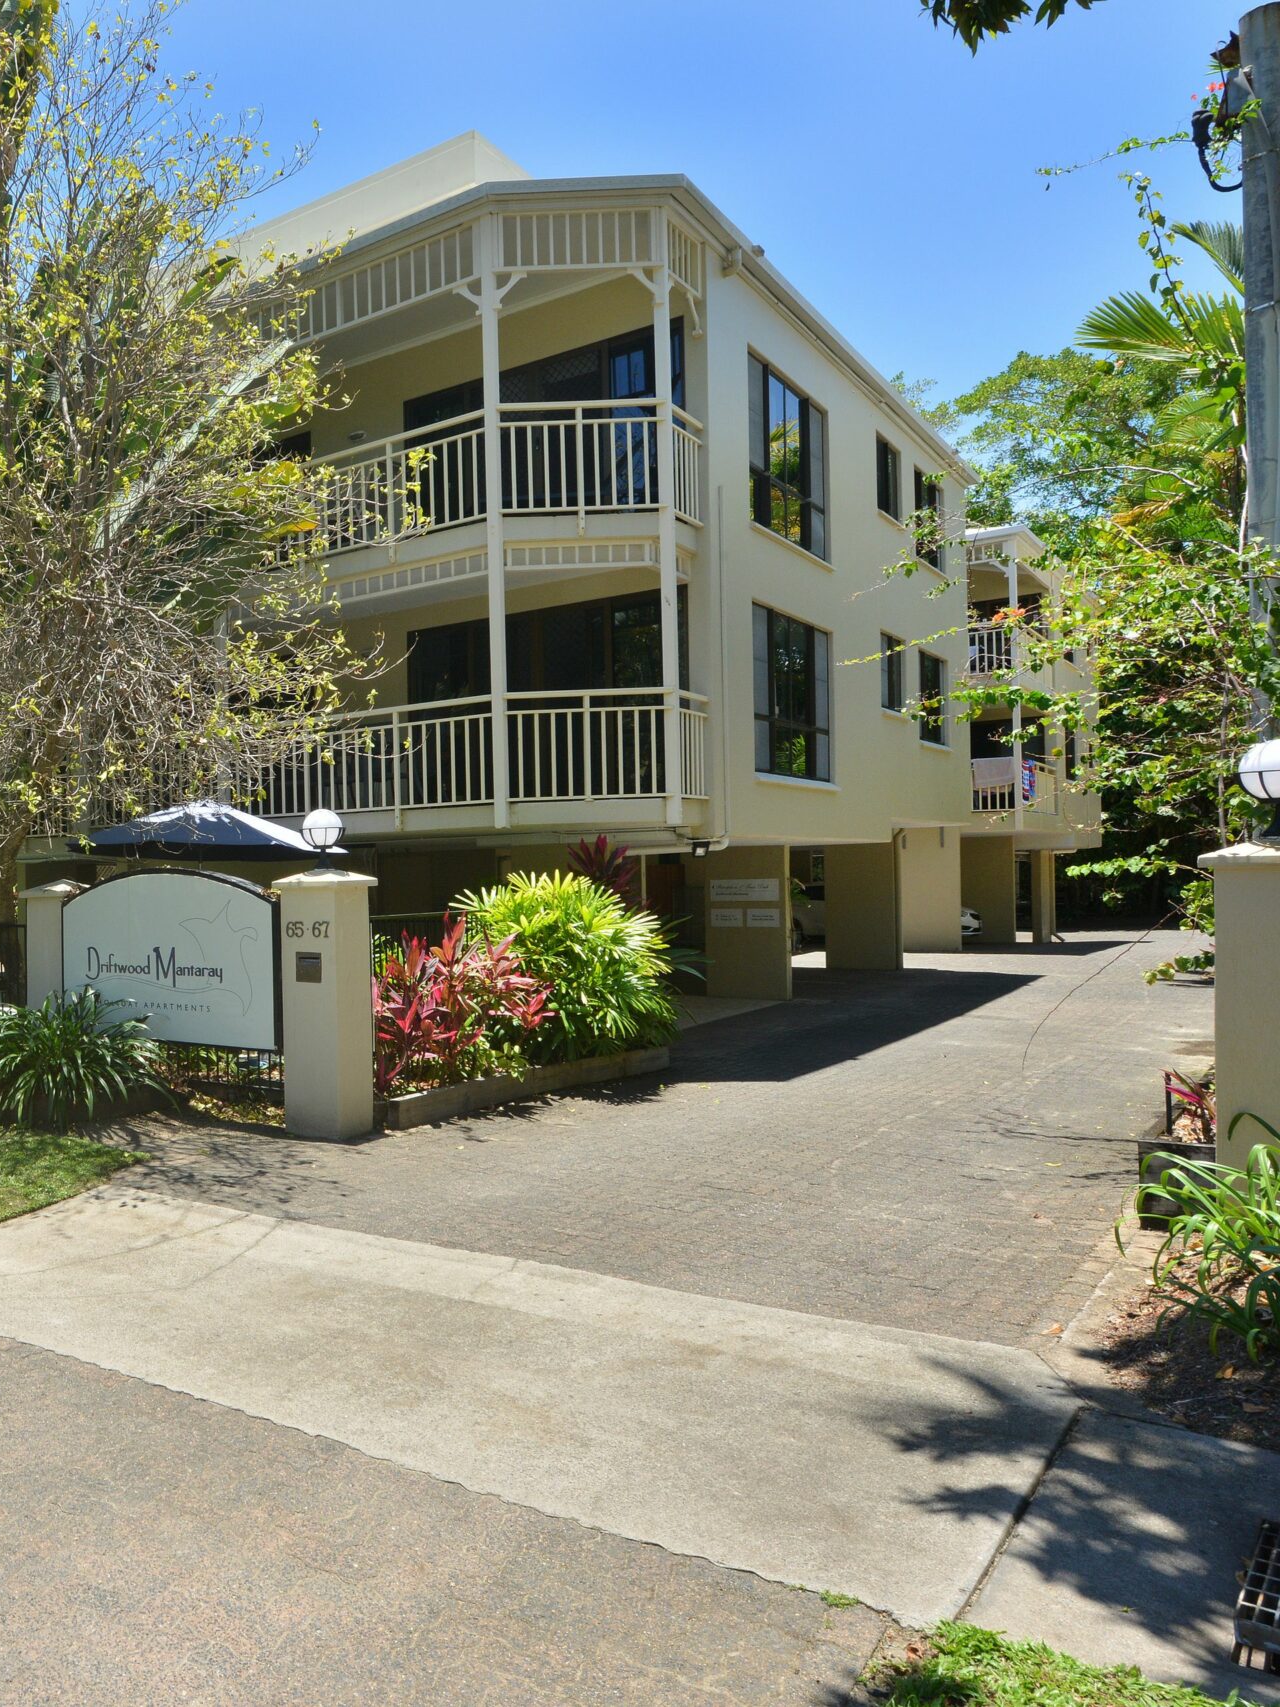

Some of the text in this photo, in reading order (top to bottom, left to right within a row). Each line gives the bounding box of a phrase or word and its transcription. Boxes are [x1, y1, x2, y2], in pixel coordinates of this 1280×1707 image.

[85, 946, 223, 988] Driftwood Mantaray
[143, 1001, 211, 1013] APARTMENTS
